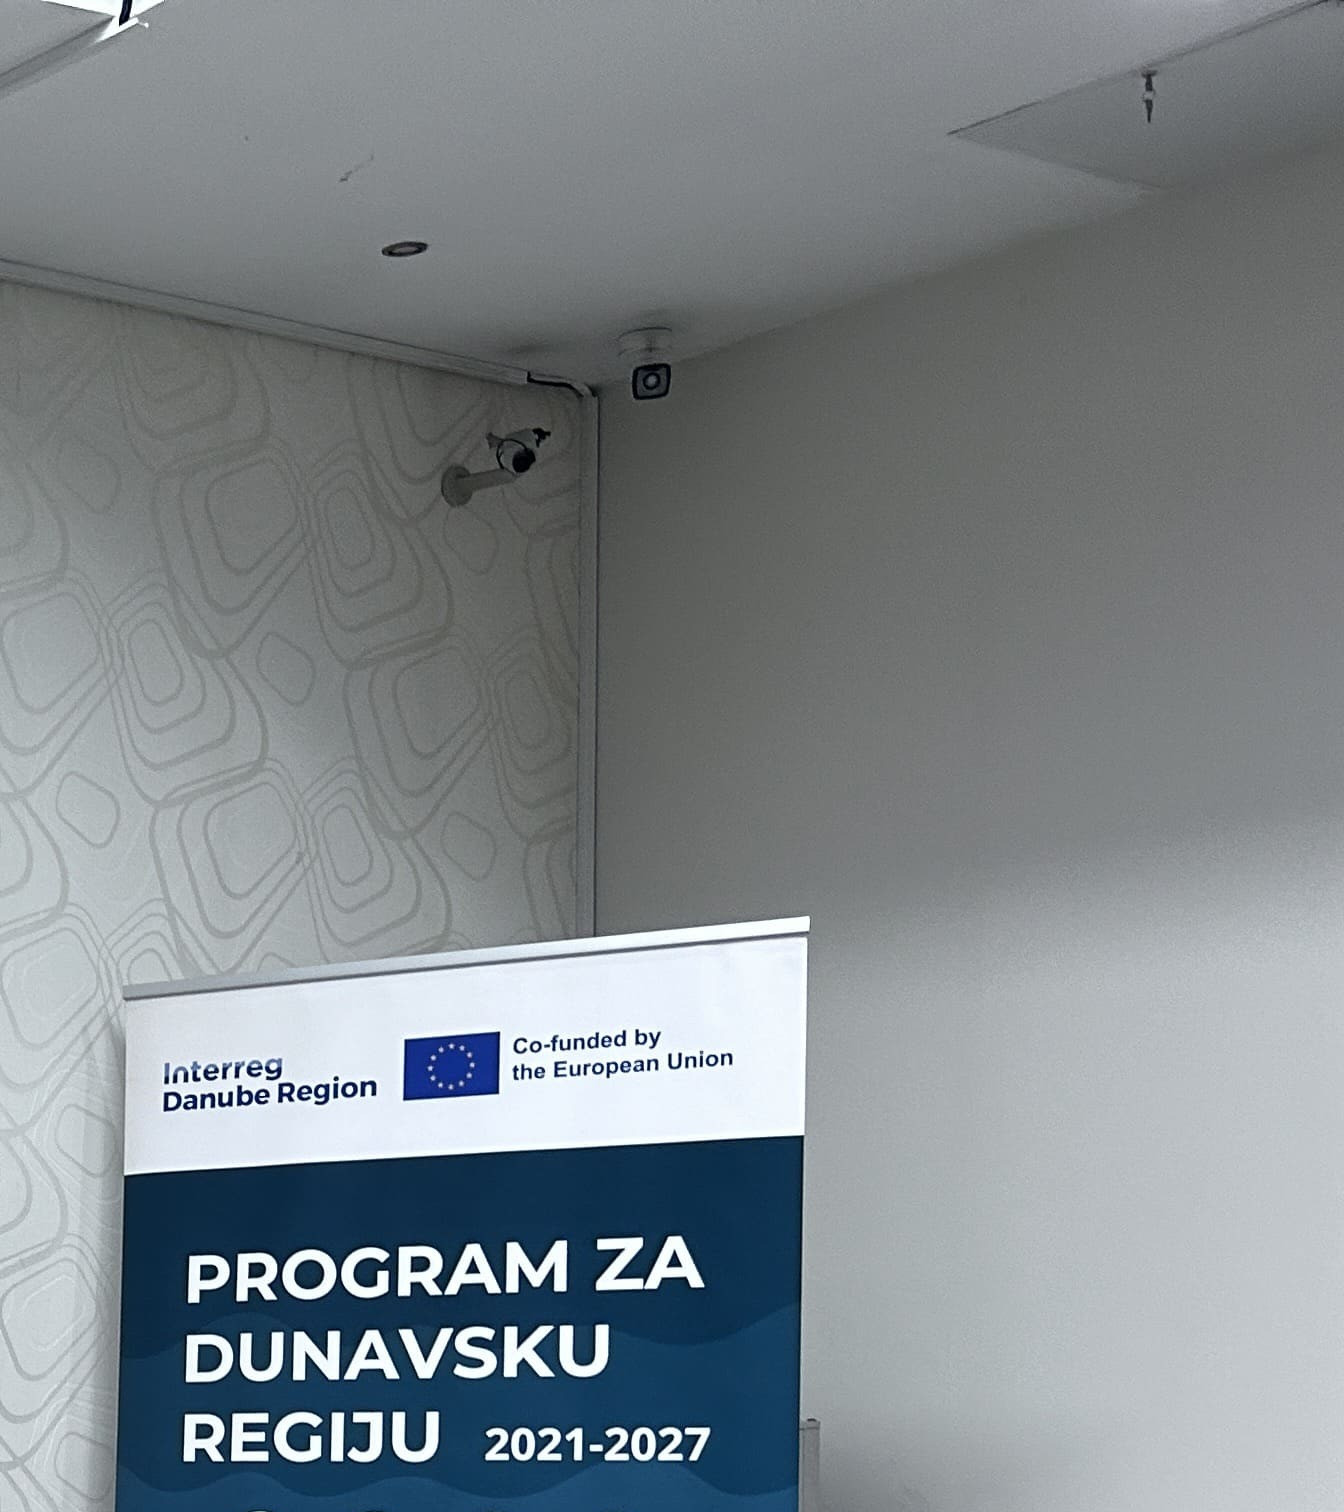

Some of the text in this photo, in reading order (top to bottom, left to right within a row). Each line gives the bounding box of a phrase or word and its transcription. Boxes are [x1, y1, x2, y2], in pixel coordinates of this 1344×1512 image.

[513, 1028, 662, 1054] Co-funded by
[163, 1057, 283, 1085] Interreg
[512, 1050, 734, 1081] the European Union
[162, 1076, 378, 1112] Danube Region
[188, 1235, 704, 1303] PROGRAM ZA
[186, 1324, 609, 1382] DUNAVSKU
[184, 1410, 710, 1462] REGIJU 2021-2027
